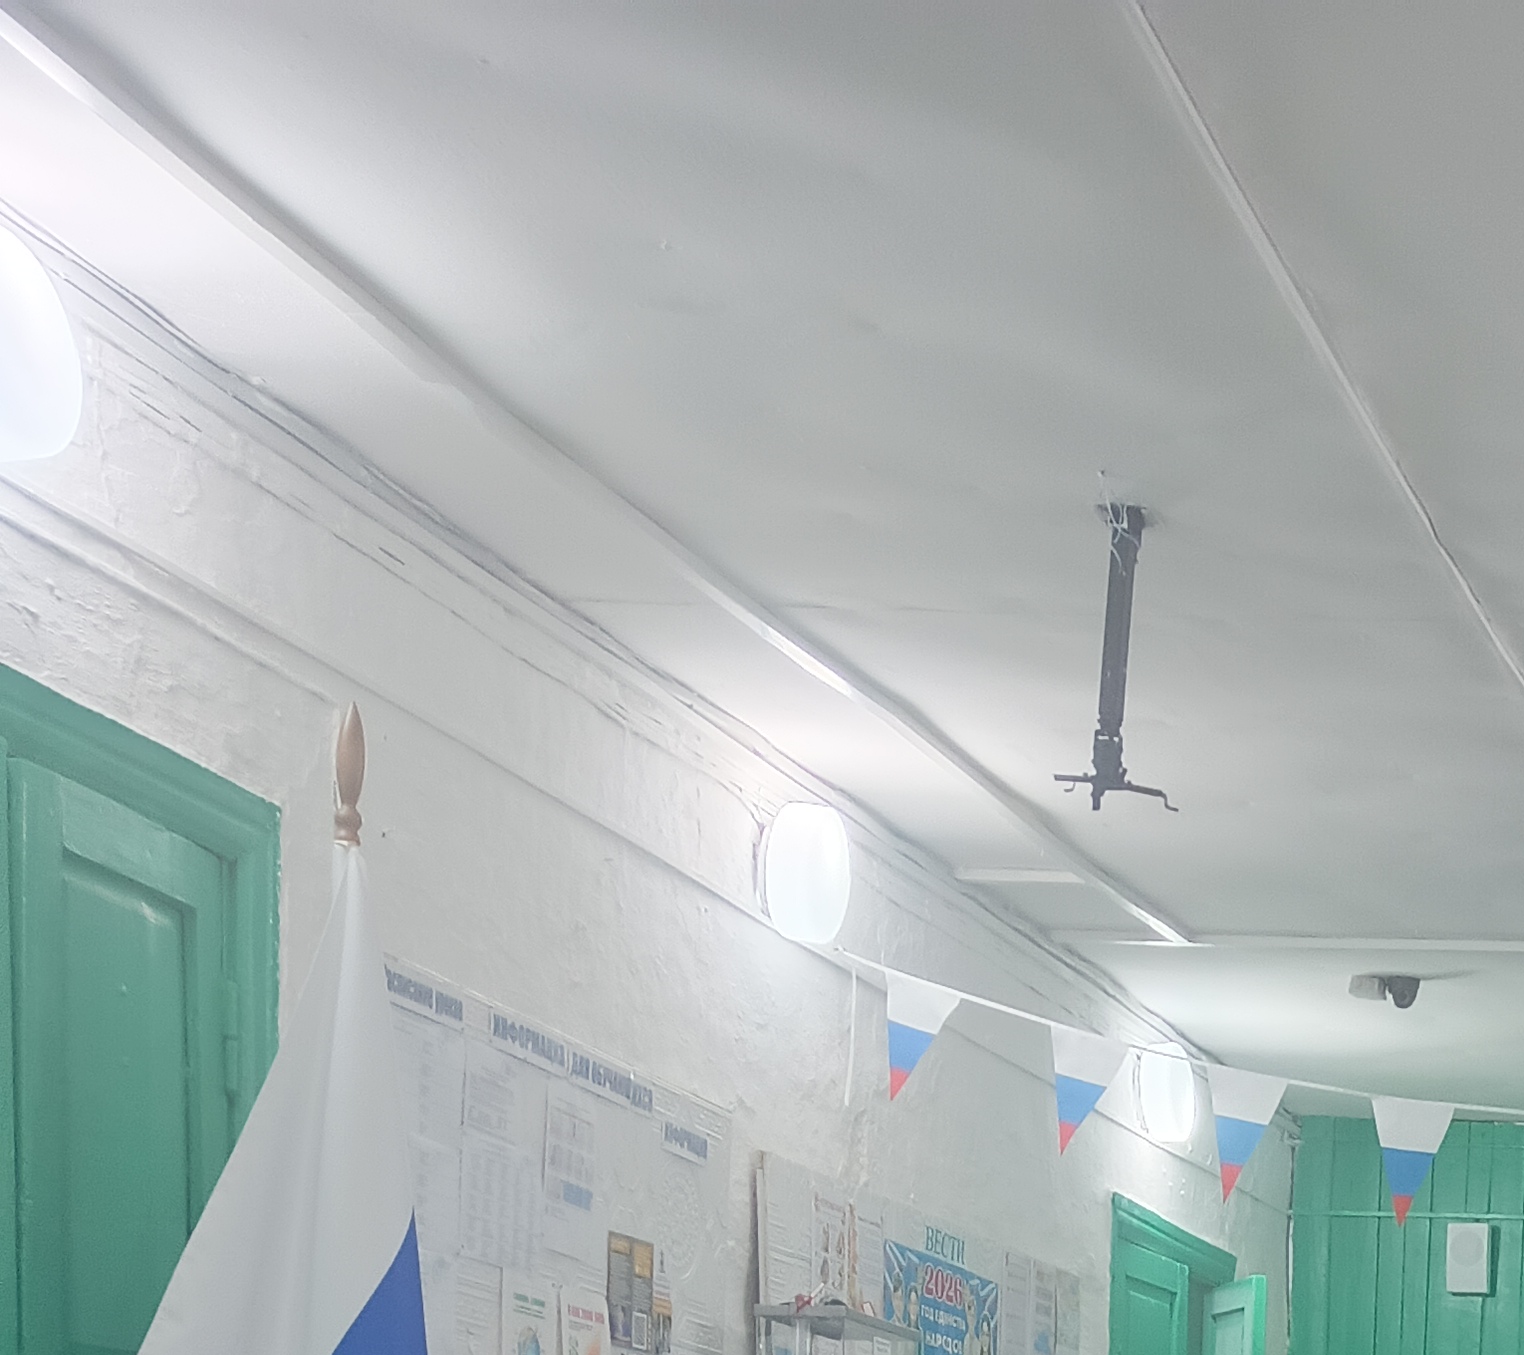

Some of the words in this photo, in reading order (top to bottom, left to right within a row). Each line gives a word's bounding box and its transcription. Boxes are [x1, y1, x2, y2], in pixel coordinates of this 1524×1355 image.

[924, 1224, 966, 1265] ВЕСТИ
[923, 1263, 964, 1309] 2026
[921, 1304, 934, 1322] ГОД
[925, 1330, 963, 1355] НАРОДОВ
